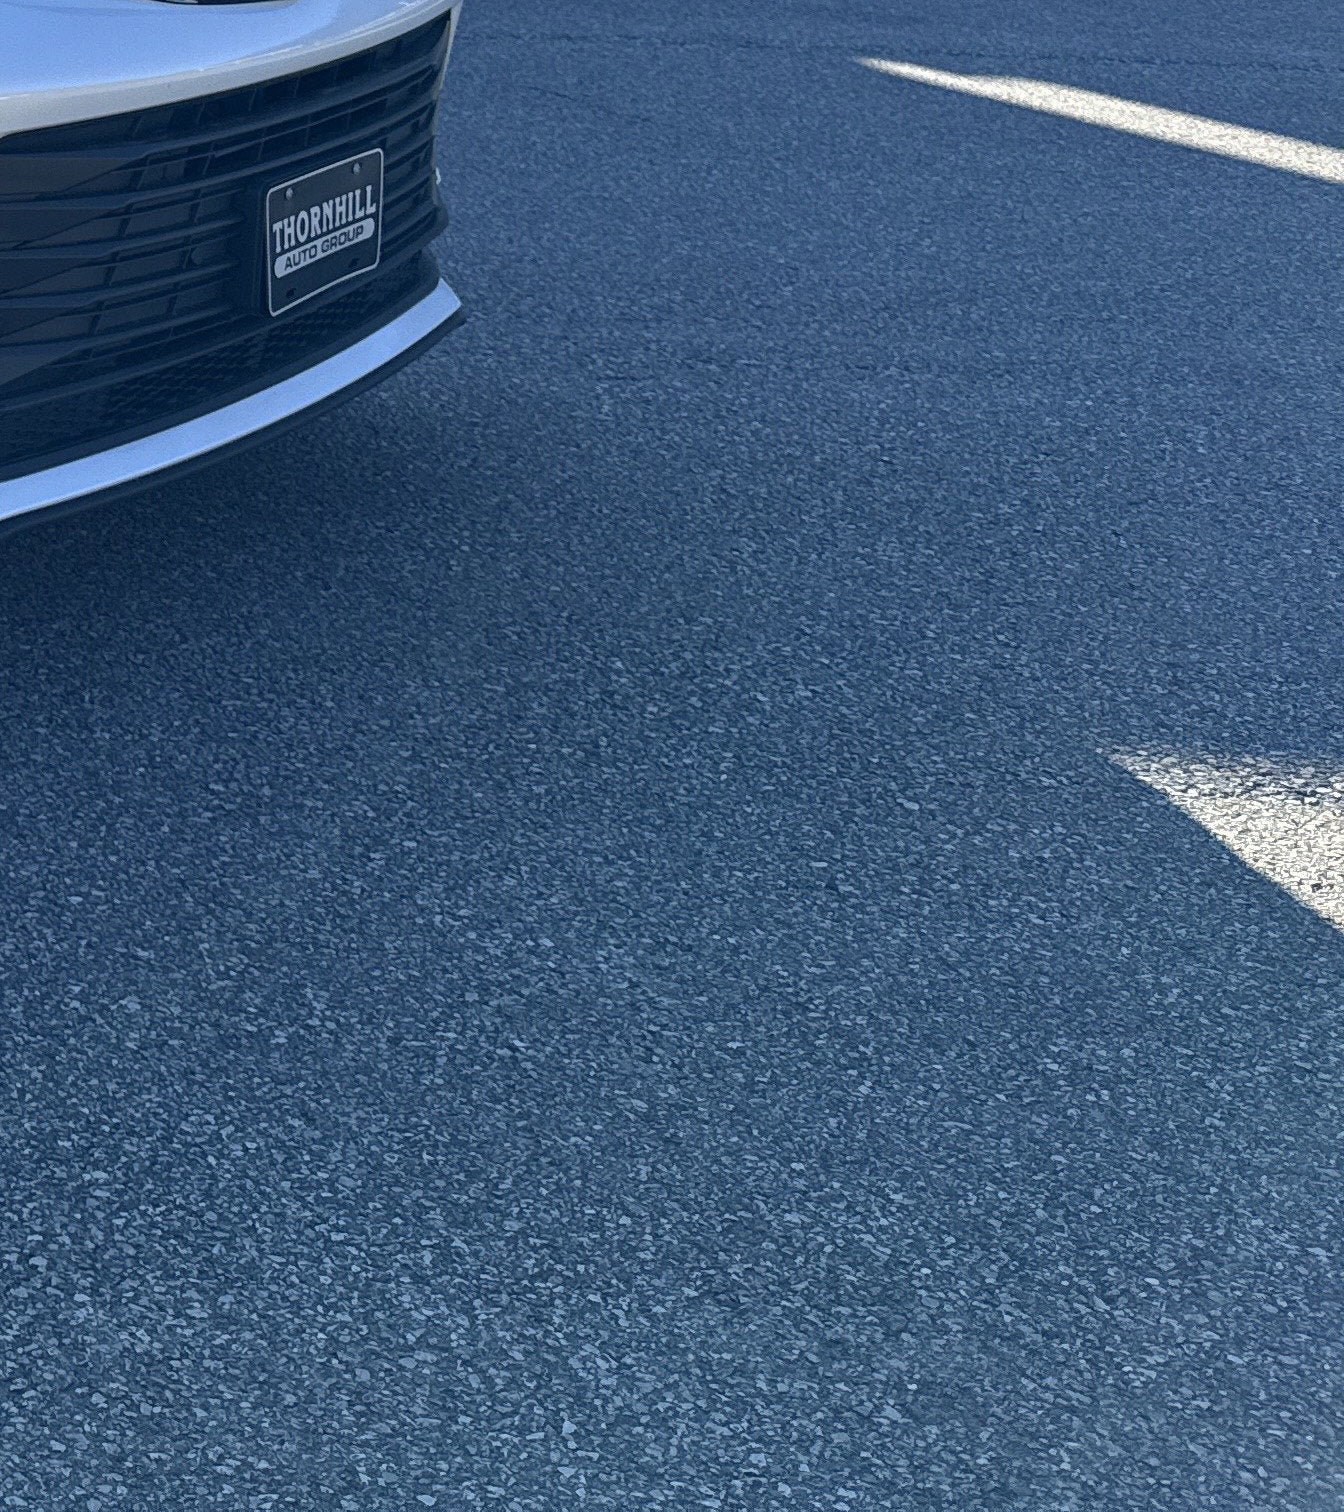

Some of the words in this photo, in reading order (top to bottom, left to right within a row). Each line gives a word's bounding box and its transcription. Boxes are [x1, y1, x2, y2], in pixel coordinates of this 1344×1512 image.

[272, 184, 377, 254] THORNHILL
[284, 246, 318, 272] AUTO
[320, 224, 365, 254] GROUP
